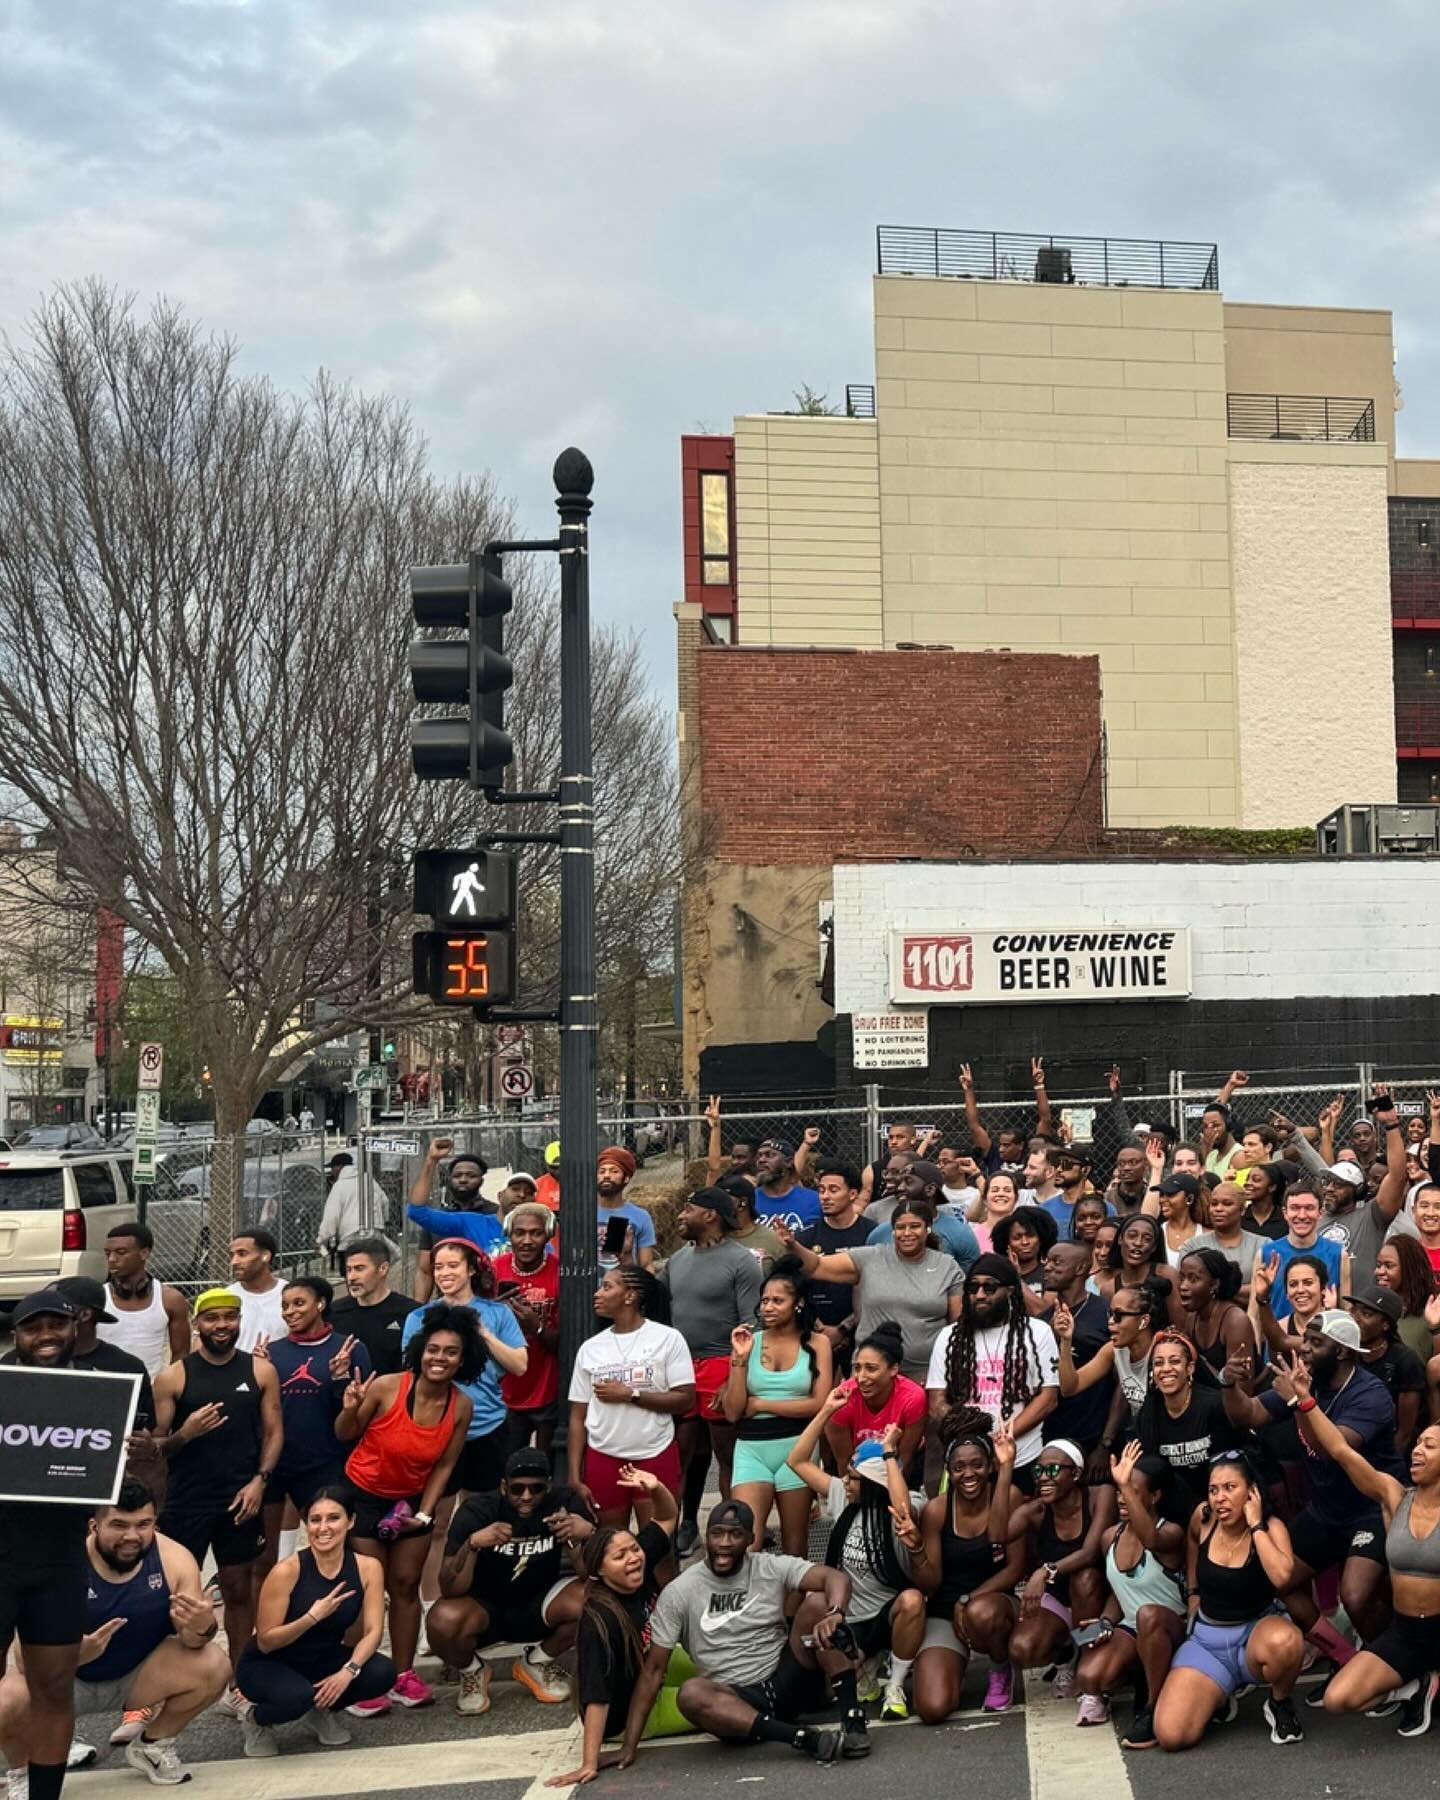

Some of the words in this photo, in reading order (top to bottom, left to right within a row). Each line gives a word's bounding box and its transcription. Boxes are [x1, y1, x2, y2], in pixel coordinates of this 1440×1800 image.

[992, 932, 1176, 953] CONVENIENCE
[447, 940, 488, 995] 35
[906, 944, 971, 987] 1101
[1000, 958, 1070, 990] BEER
[1090, 955, 1166, 988] WINE
[855, 1017, 877, 1030] DRUG
[880, 1016, 901, 1029] FREE
[903, 1016, 925, 1029] ZONE
[880, 1036, 925, 1044] LOITERING
[0, 1423, 112, 1450] overs
[518, 1536, 554, 1556] TEAM
[709, 1591, 749, 1613] NIKE
